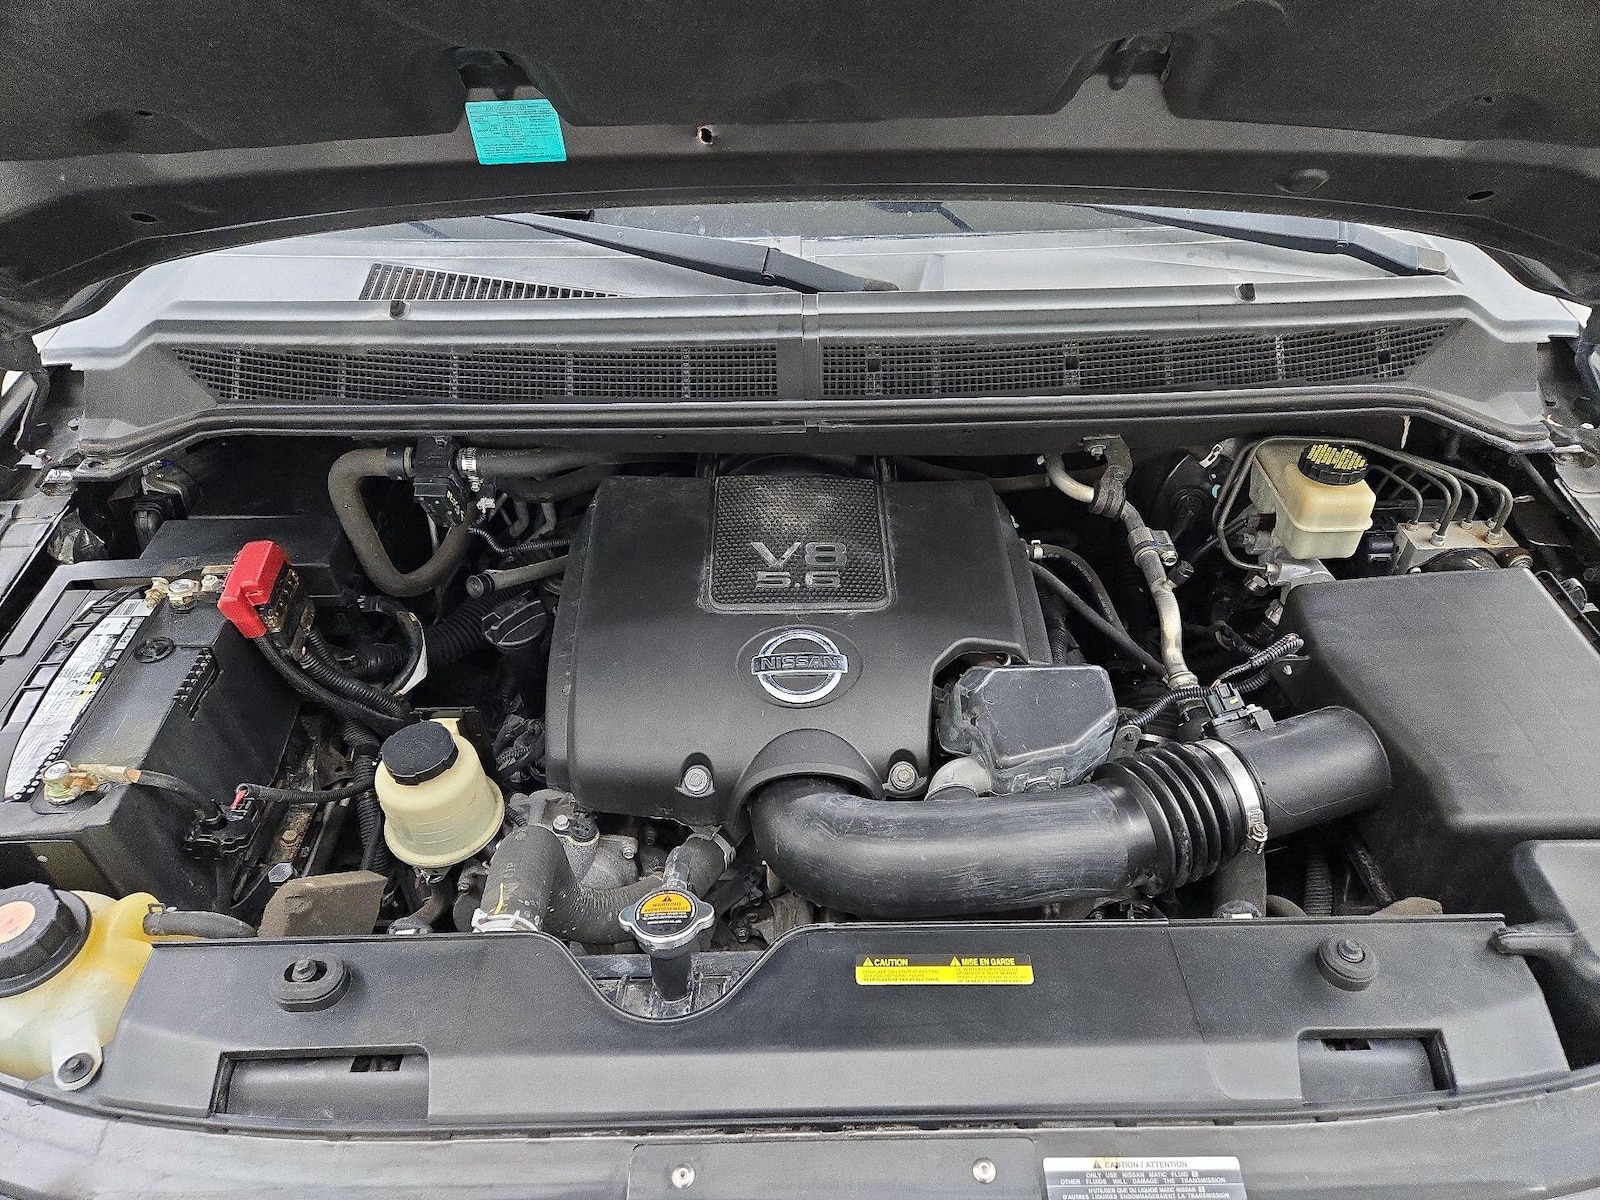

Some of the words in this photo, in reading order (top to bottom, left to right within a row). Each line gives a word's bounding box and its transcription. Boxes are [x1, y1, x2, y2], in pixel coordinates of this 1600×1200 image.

[751, 541, 848, 567] V8
[756, 571, 841, 588] 5.6
[760, 655, 839, 670] NISSAN
[873, 958, 908, 967] CAUTION
[961, 958, 979, 966] MISE
[979, 958, 990, 966] EN
[990, 958, 1016, 966] GARDE
